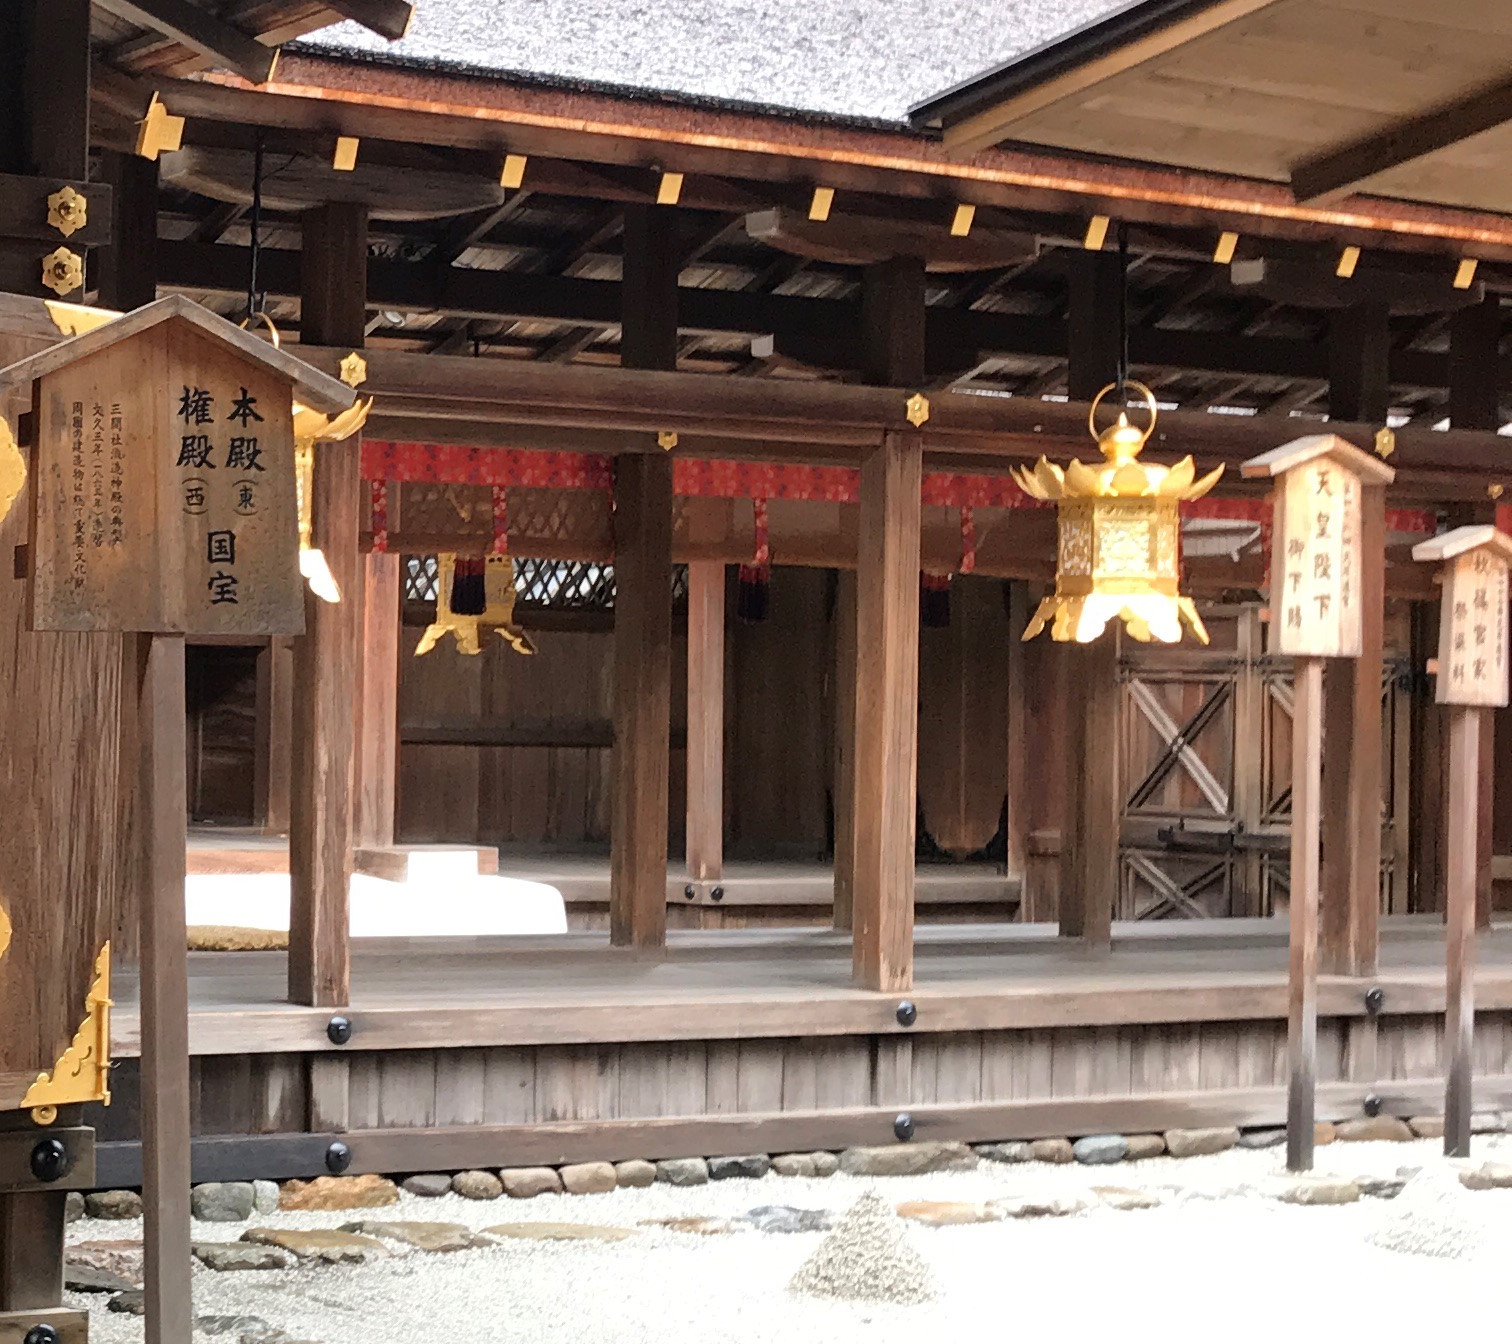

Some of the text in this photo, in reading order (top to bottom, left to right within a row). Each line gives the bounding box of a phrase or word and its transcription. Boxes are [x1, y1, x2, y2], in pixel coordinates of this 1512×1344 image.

[176, 384, 217, 516] 権殿（西）
[224, 386, 266, 516] 本殿（東）
[206, 529, 239, 605] 国宝
[1313, 469, 1333, 621] 天皇陛下
